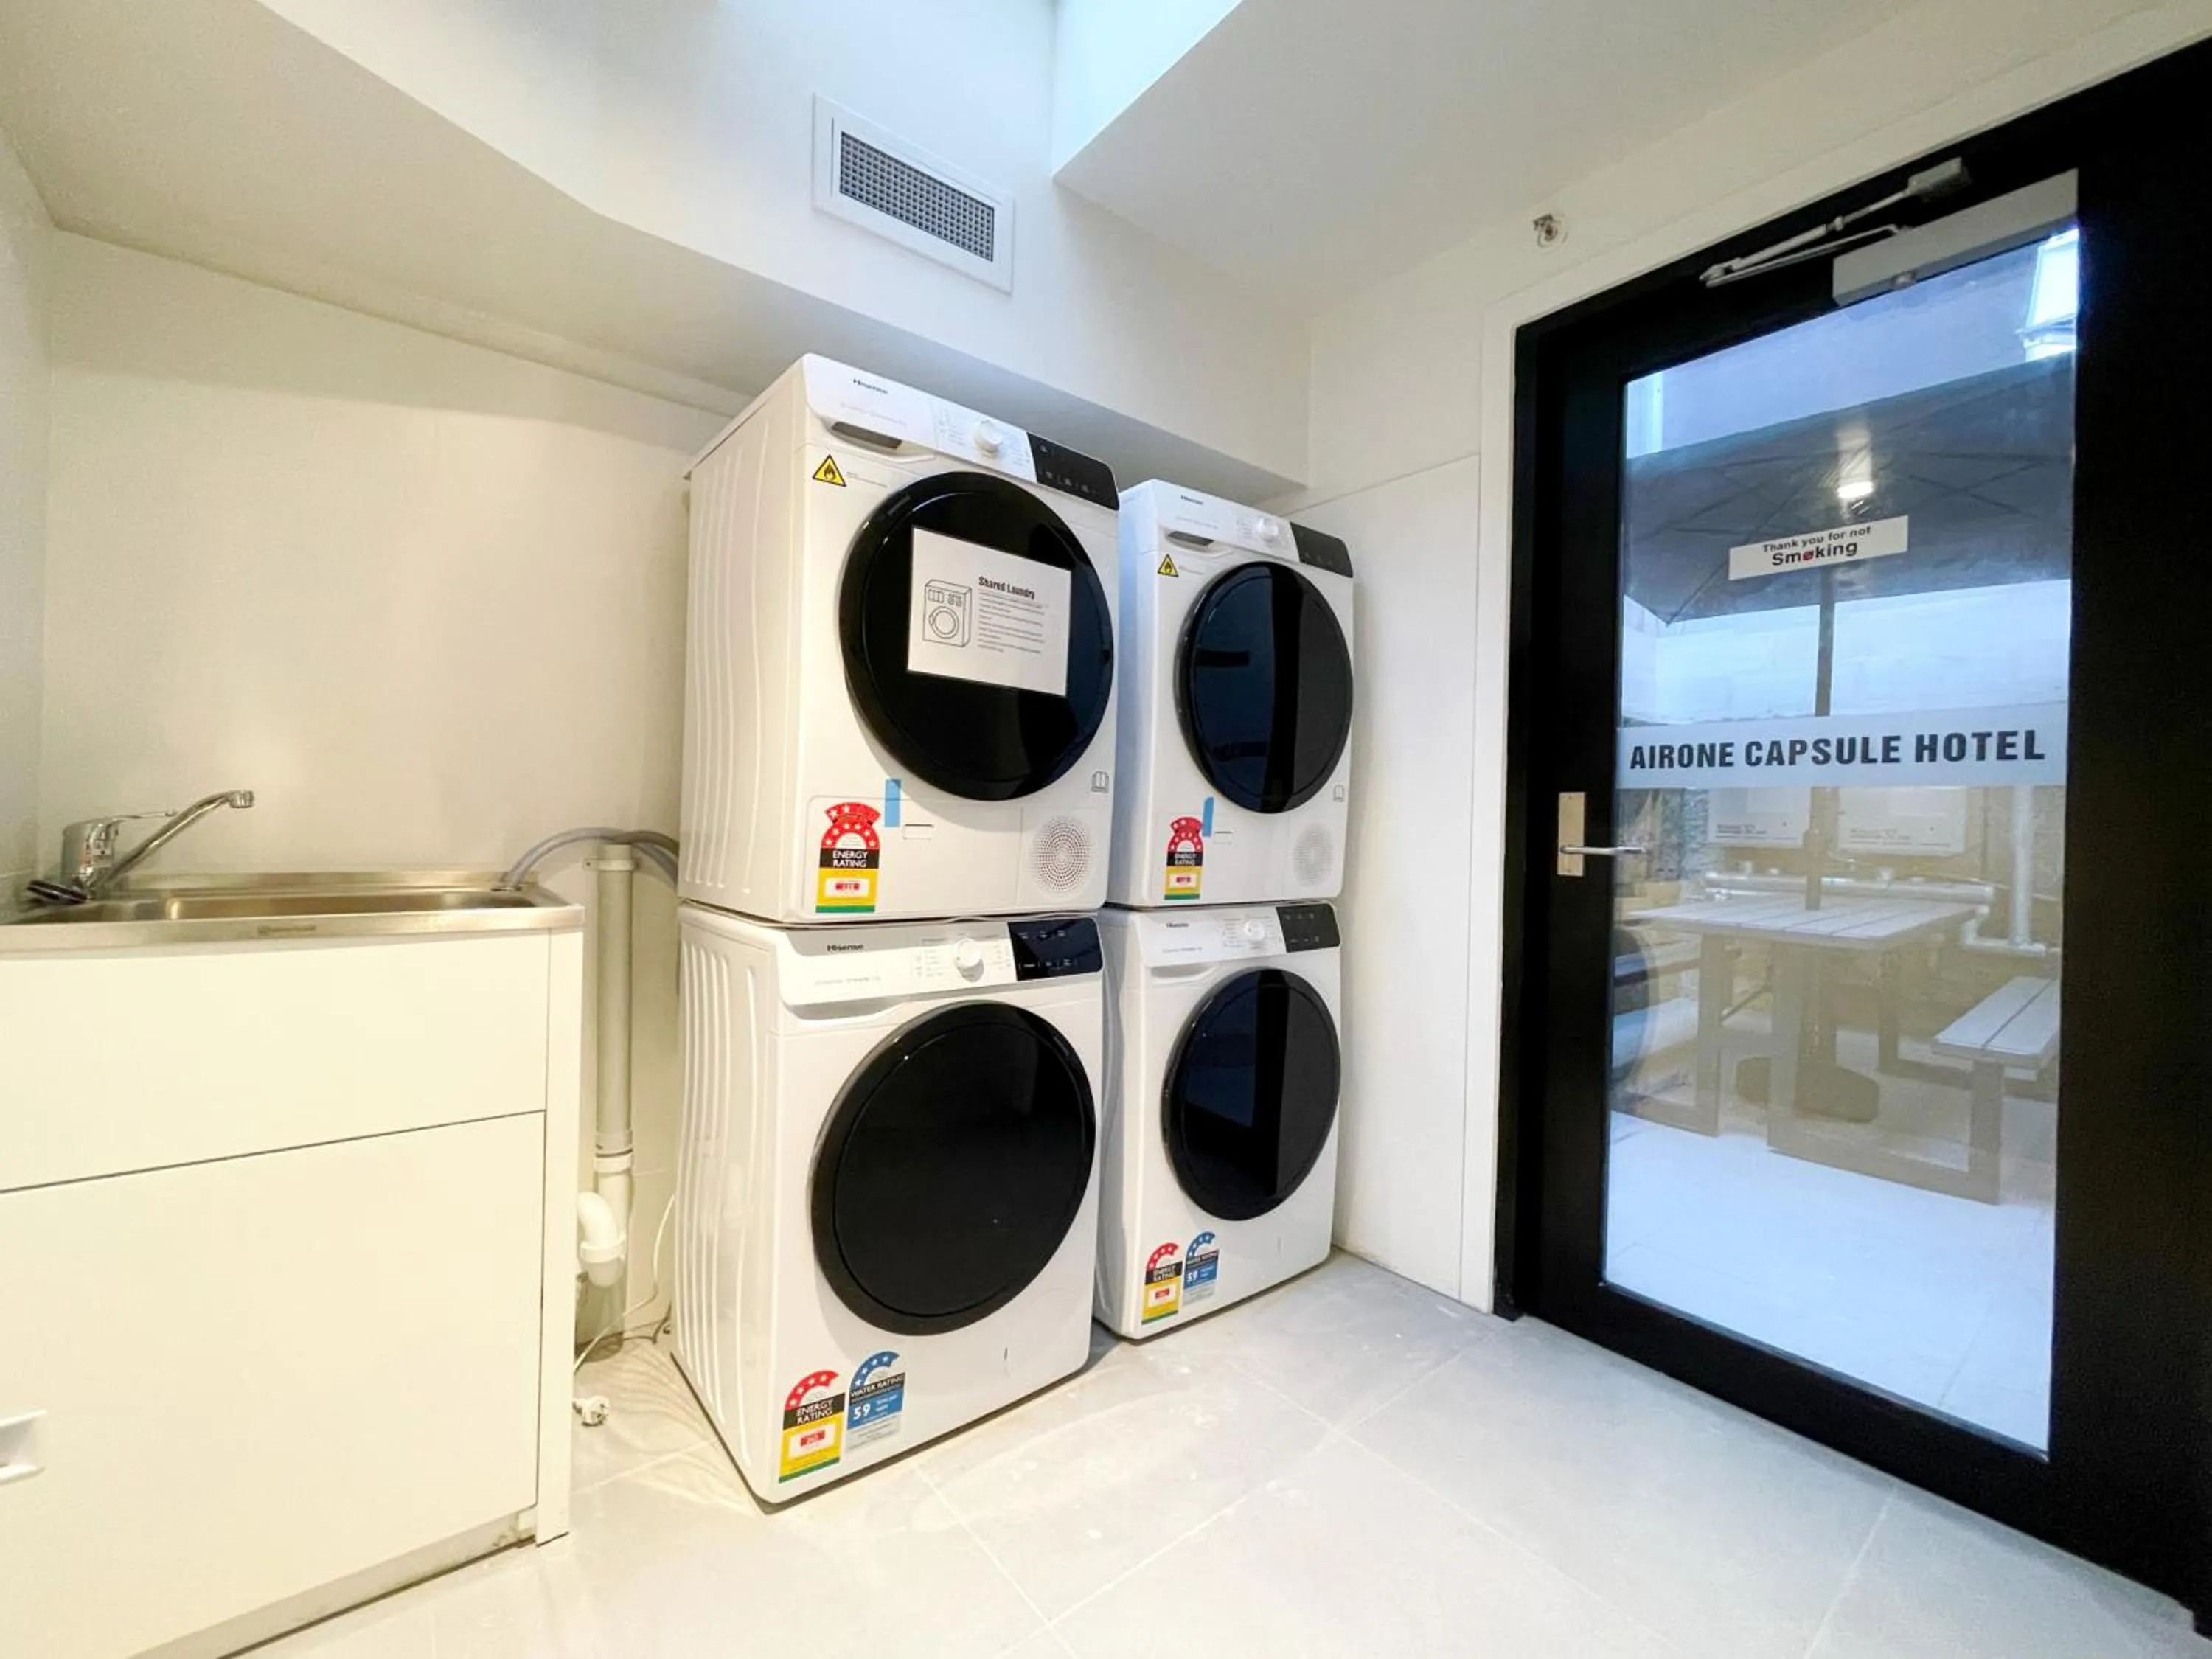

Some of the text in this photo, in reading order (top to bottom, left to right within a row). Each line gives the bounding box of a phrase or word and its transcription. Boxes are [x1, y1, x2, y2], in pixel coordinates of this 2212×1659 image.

[1763, 526, 1871, 553] Thank you for not
[1772, 542, 1858, 566] Smoking
[978, 576, 1035, 600] Shared Laundry
[1630, 729, 2046, 770] AIRONE CAPSULE HOTEL
[833, 850, 868, 859] ENERGY
[833, 859, 867, 868] RATING
[797, 1398, 833, 1417] ENERGY
[797, 1409, 832, 1425] RATING
[853, 1403, 871, 1421] 59
